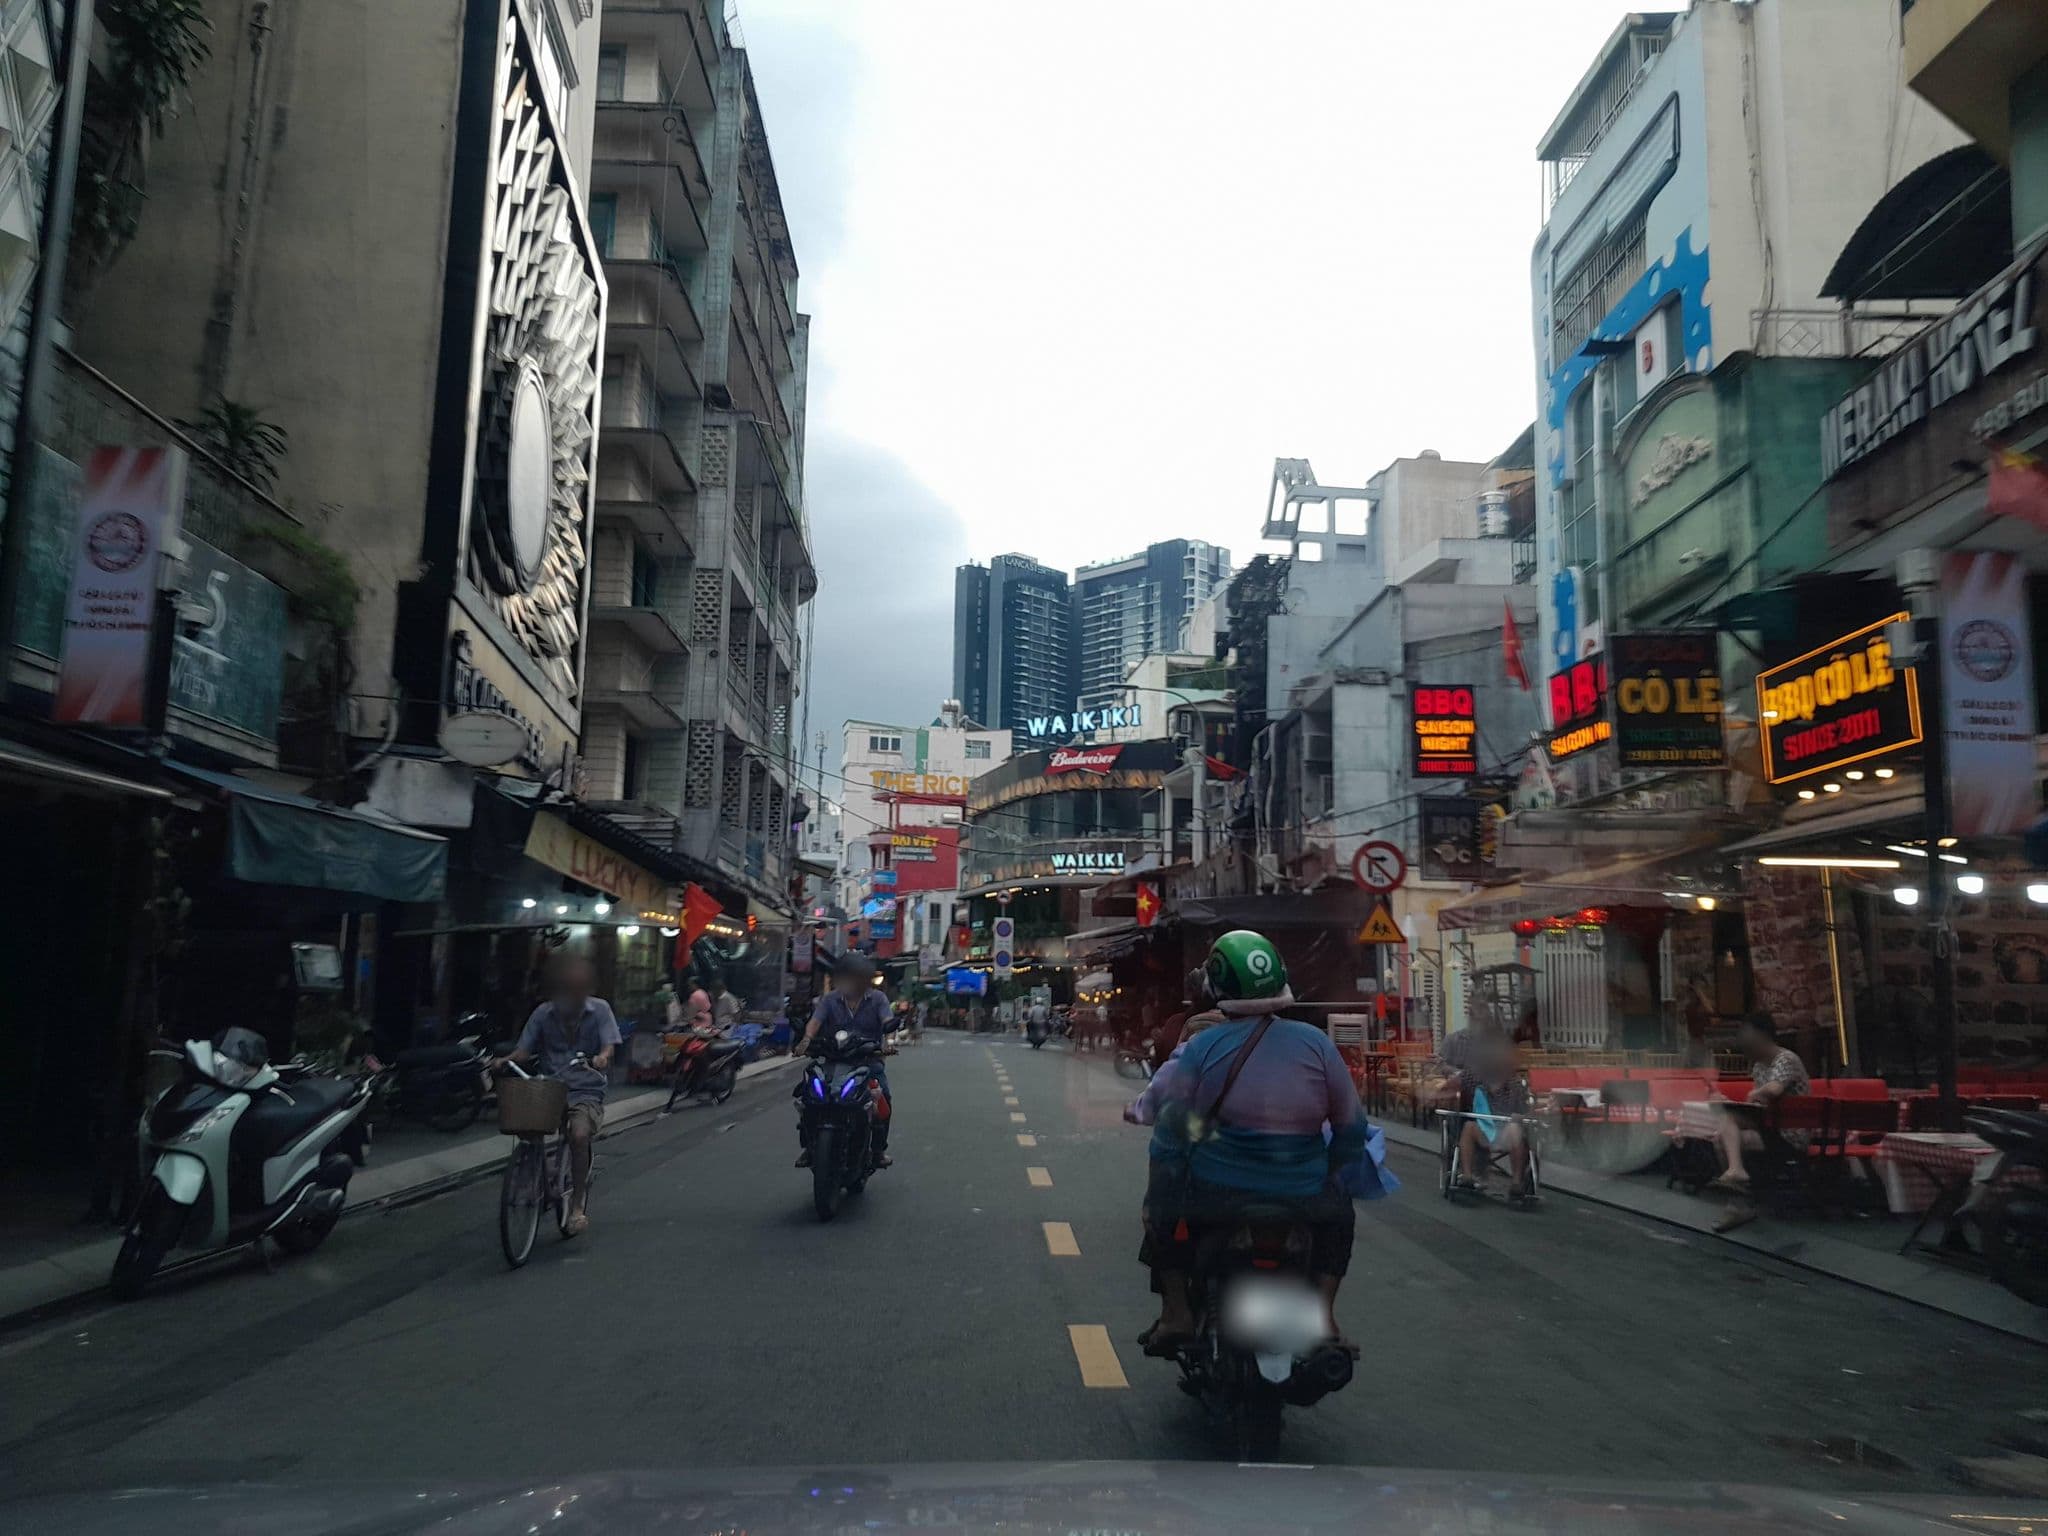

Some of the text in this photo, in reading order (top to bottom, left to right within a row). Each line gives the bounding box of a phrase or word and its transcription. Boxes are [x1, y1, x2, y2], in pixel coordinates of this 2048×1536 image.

[1414, 689, 1473, 715] BBQ
[1763, 675, 1815, 726] BBQ
[1027, 704, 1140, 737] WAIKIKI
[1415, 720, 1475, 734] SAIGON
[1420, 736, 1470, 751] NIGHT
[1784, 708, 1881, 760] SINCE 2011
[1049, 751, 1117, 767] Budweiser
[870, 770, 917, 793] THE
[1051, 852, 1124, 867] WAIKIKI
